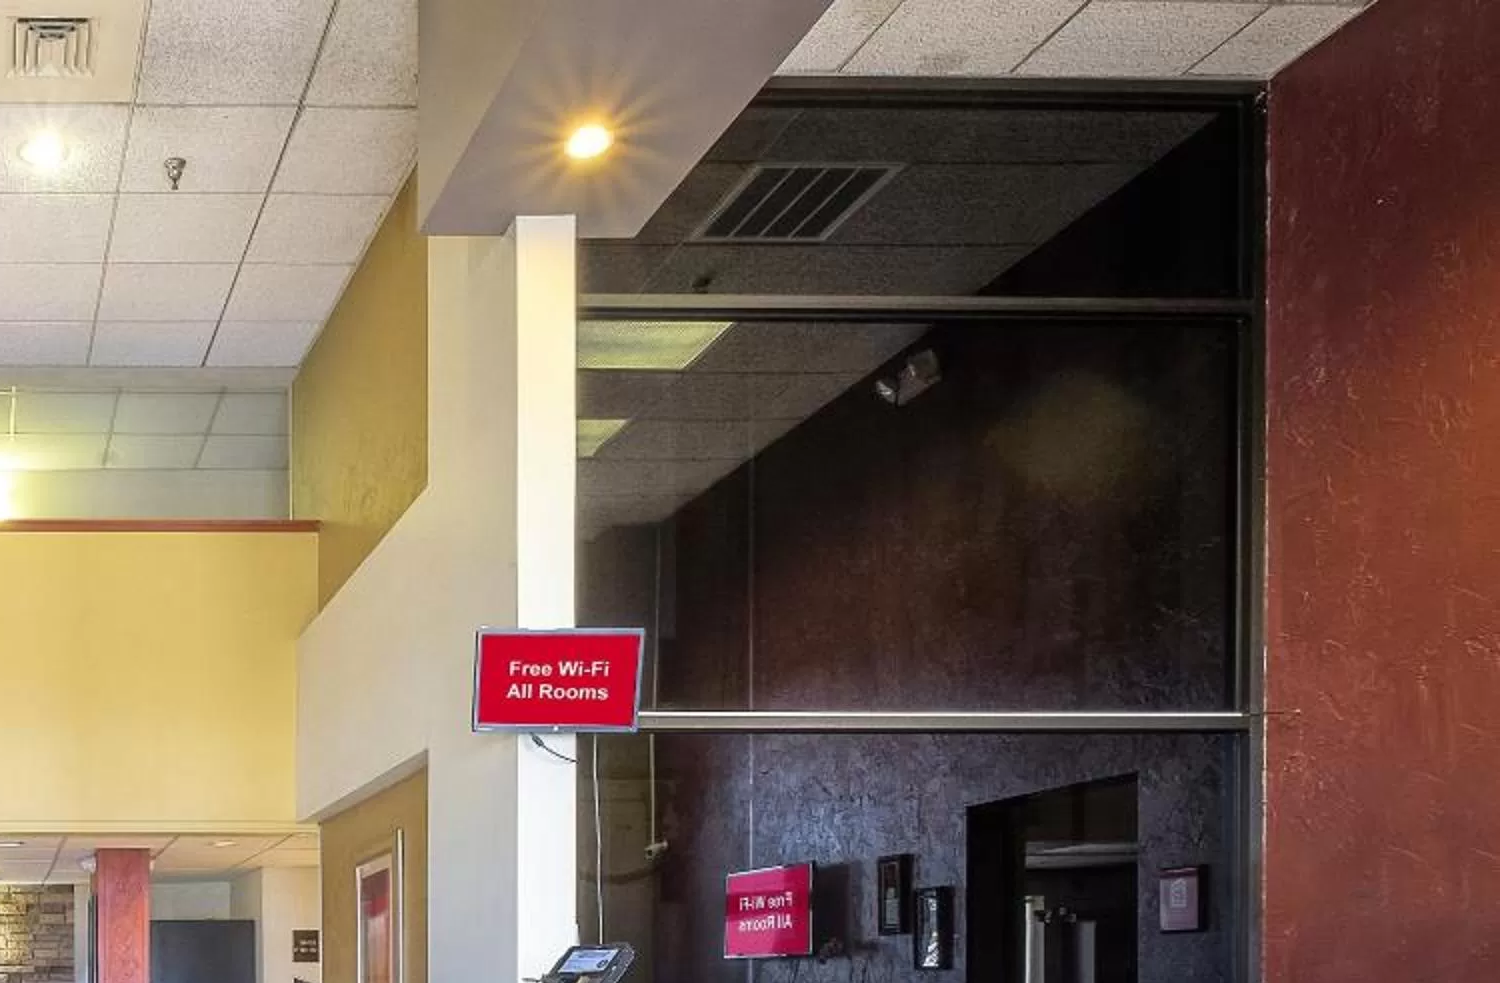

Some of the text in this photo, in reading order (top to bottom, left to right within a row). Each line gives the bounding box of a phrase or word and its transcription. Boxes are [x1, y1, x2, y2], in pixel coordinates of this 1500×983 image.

[509, 661, 610, 677] Free Wi-Fi
[506, 683, 609, 701] All Rooms
